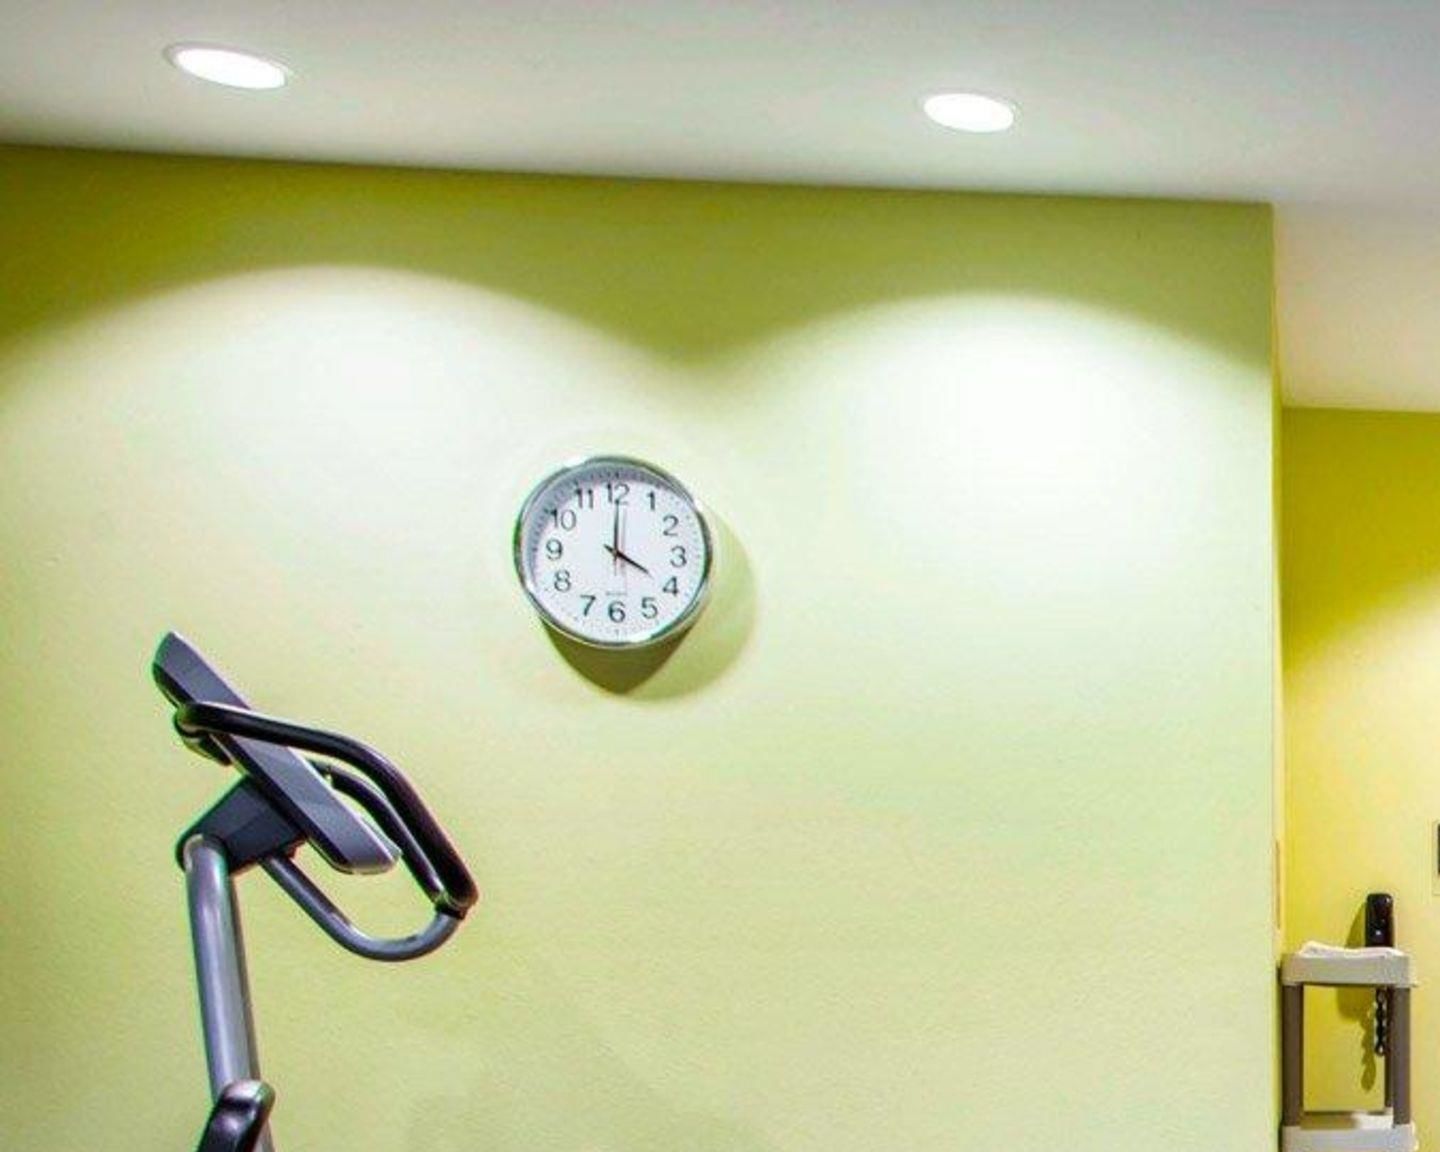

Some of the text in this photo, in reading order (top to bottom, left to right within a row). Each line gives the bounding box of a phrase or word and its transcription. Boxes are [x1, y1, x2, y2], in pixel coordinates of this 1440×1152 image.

[575, 488, 594, 510] 11
[606, 482, 631, 506] 12
[646, 491, 656, 511] 1
[552, 508, 577, 532] 10
[662, 515, 680, 537] 2
[546, 538, 564, 561] 9
[670, 545, 687, 568] 3
[554, 569, 571, 593] 8
[662, 575, 679, 597] 4
[580, 594, 597, 617] 7
[608, 601, 626, 623] 6
[641, 596, 659, 619] 5
